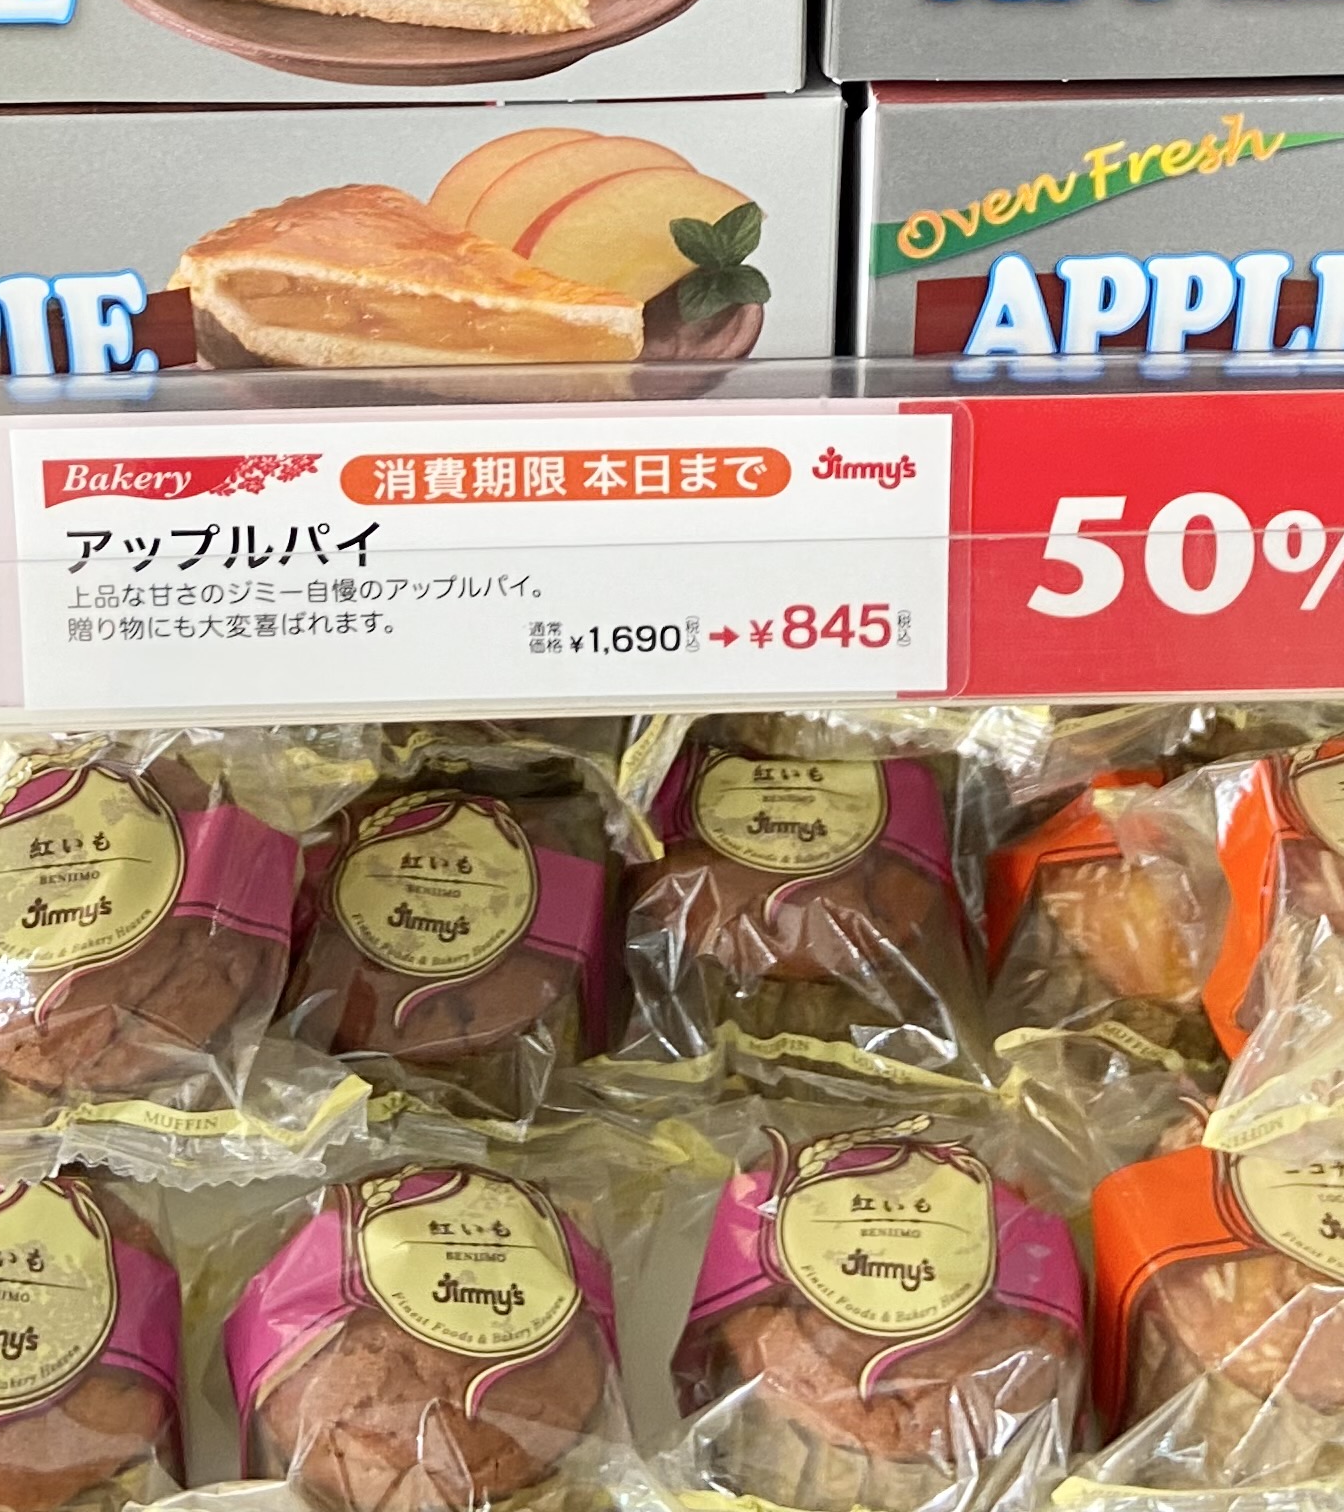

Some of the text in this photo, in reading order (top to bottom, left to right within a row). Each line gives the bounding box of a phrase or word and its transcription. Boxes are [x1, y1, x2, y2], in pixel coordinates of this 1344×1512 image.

[897, 112, 1286, 260] Oven Fresh
[62, 461, 192, 499] Bakery
[373, 454, 769, 501] 消費期限 本日まで
[811, 446, 917, 490] Jimmy's
[65, 521, 381, 575] アップルパイ
[68, 575, 543, 609] 上品な甘さのジミー自慢のアップルパイ。
[67, 610, 396, 643] 贈り物にも大変喜ばれます。
[569, 624, 682, 656] ¥1,690
[749, 603, 892, 650] ¥845
[747, 811, 828, 842] Jimmy's
[29, 831, 110, 859] 紅いも
[400, 852, 473, 874] 紅いも
[21, 896, 112, 928] Jimmy's
[387, 902, 471, 942] Jimmy's
[143, 1110, 218, 1131] MUFFIN
[850, 1193, 932, 1214] 紅いも
[428, 1220, 511, 1238] 紅いも
[841, 1248, 935, 1292] Jimmy's
[432, 1272, 525, 1315] Jimmy's
